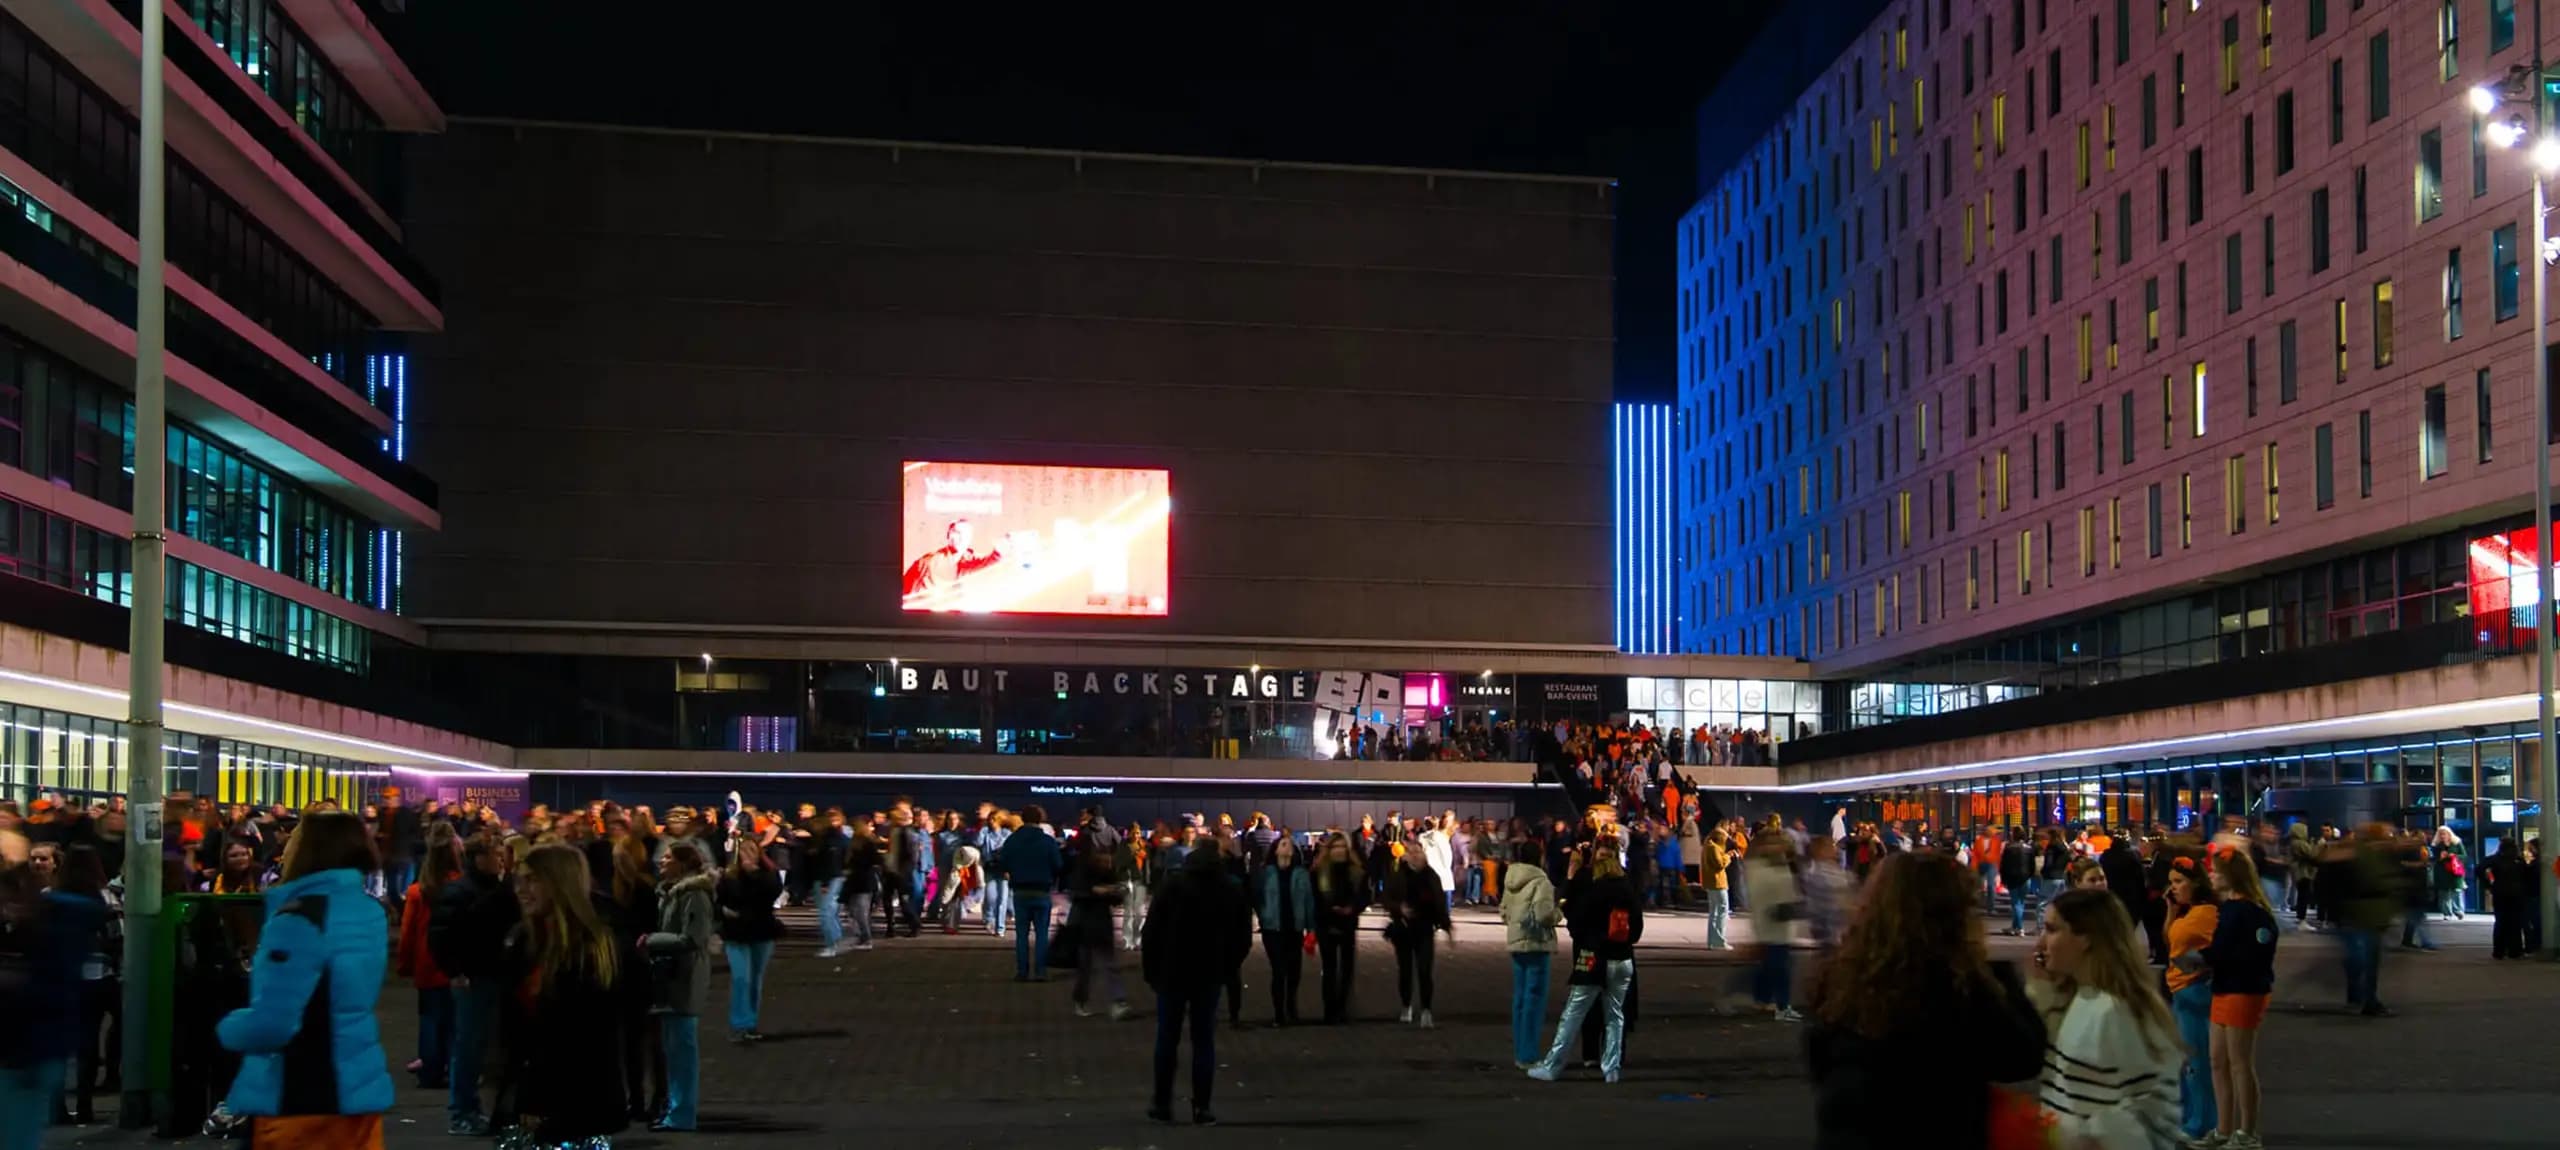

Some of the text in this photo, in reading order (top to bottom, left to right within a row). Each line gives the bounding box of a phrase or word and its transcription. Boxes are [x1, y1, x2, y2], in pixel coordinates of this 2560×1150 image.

[900, 667, 1304, 697] BAUT BACKSTAGE
[1462, 686, 1511, 695] INGANG
[1544, 684, 1598, 692] RESTAURANT
[1547, 692, 1598, 701] BAR-EVENTS
[465, 787, 520, 798] BUSINESS
